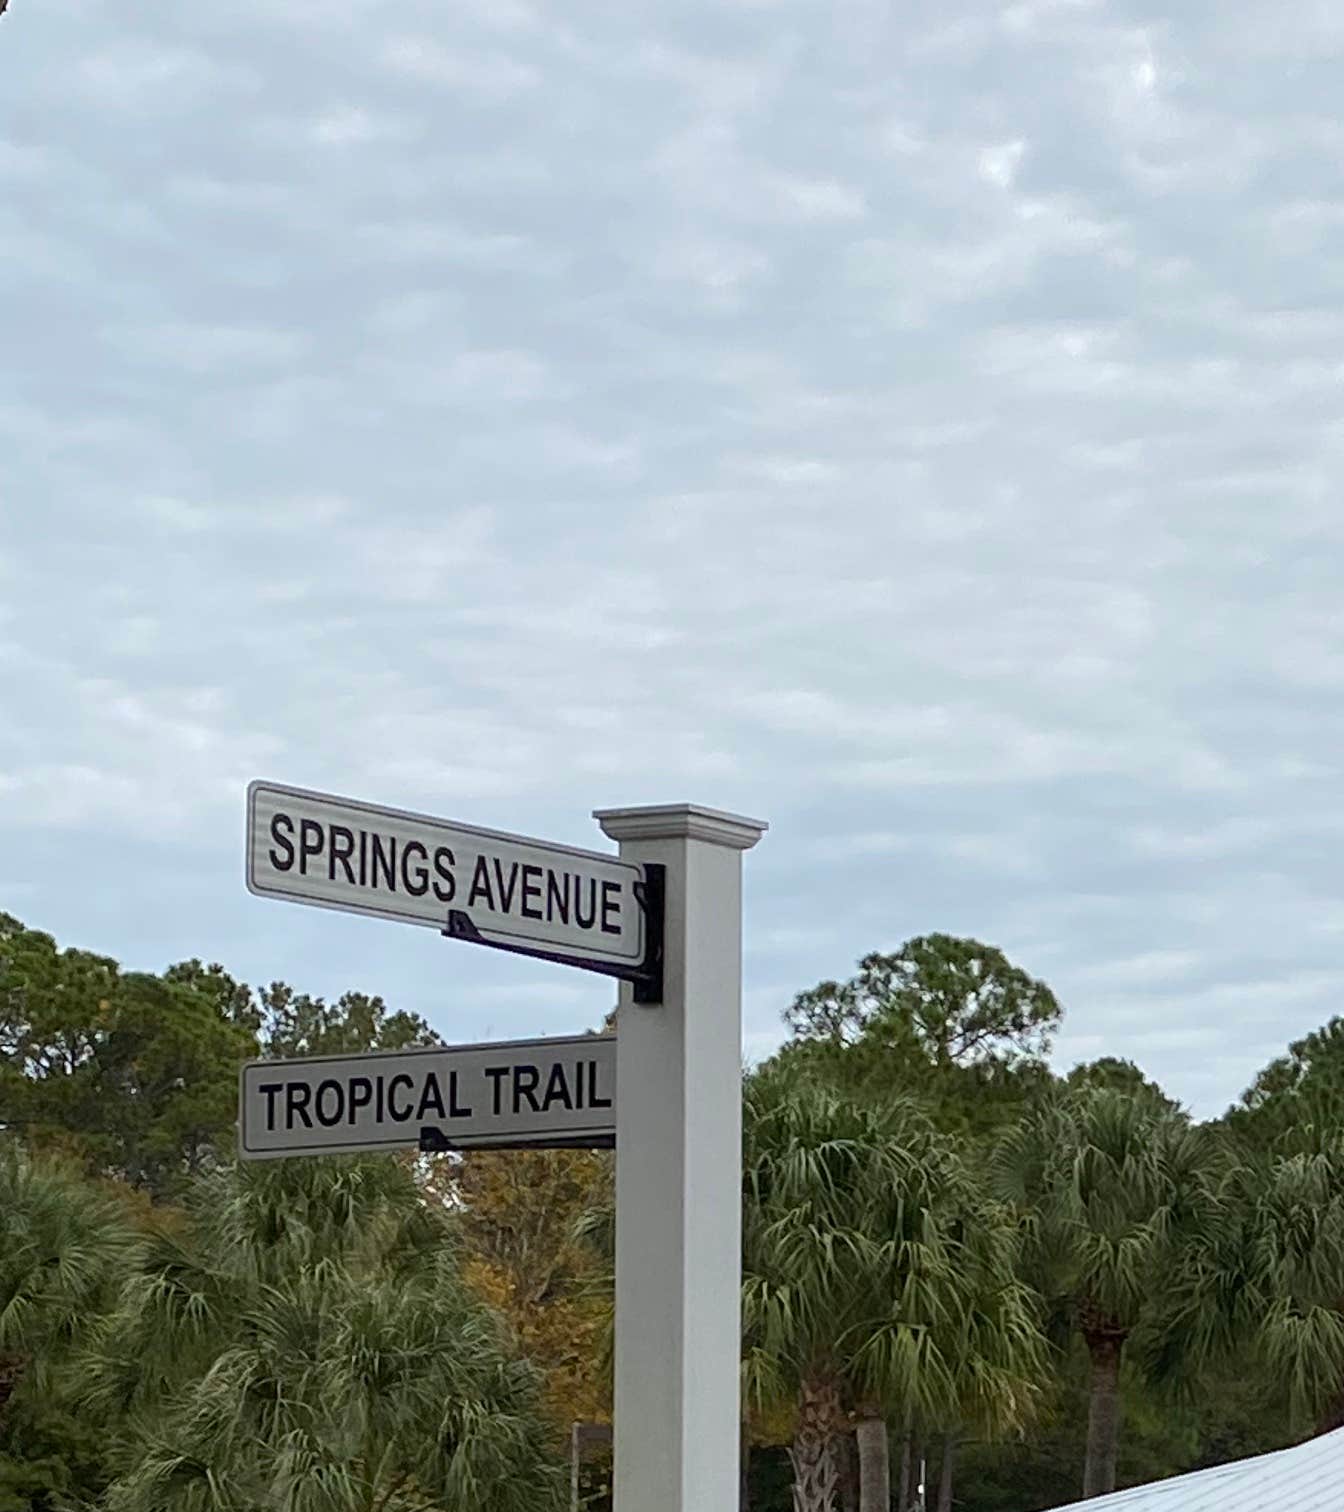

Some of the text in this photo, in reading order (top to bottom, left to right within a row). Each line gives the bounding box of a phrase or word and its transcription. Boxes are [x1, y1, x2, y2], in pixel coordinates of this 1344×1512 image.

[268, 812, 623, 935] SPRINGS AVENUE
[258, 1060, 613, 1131] TROPICAL TRAIL
